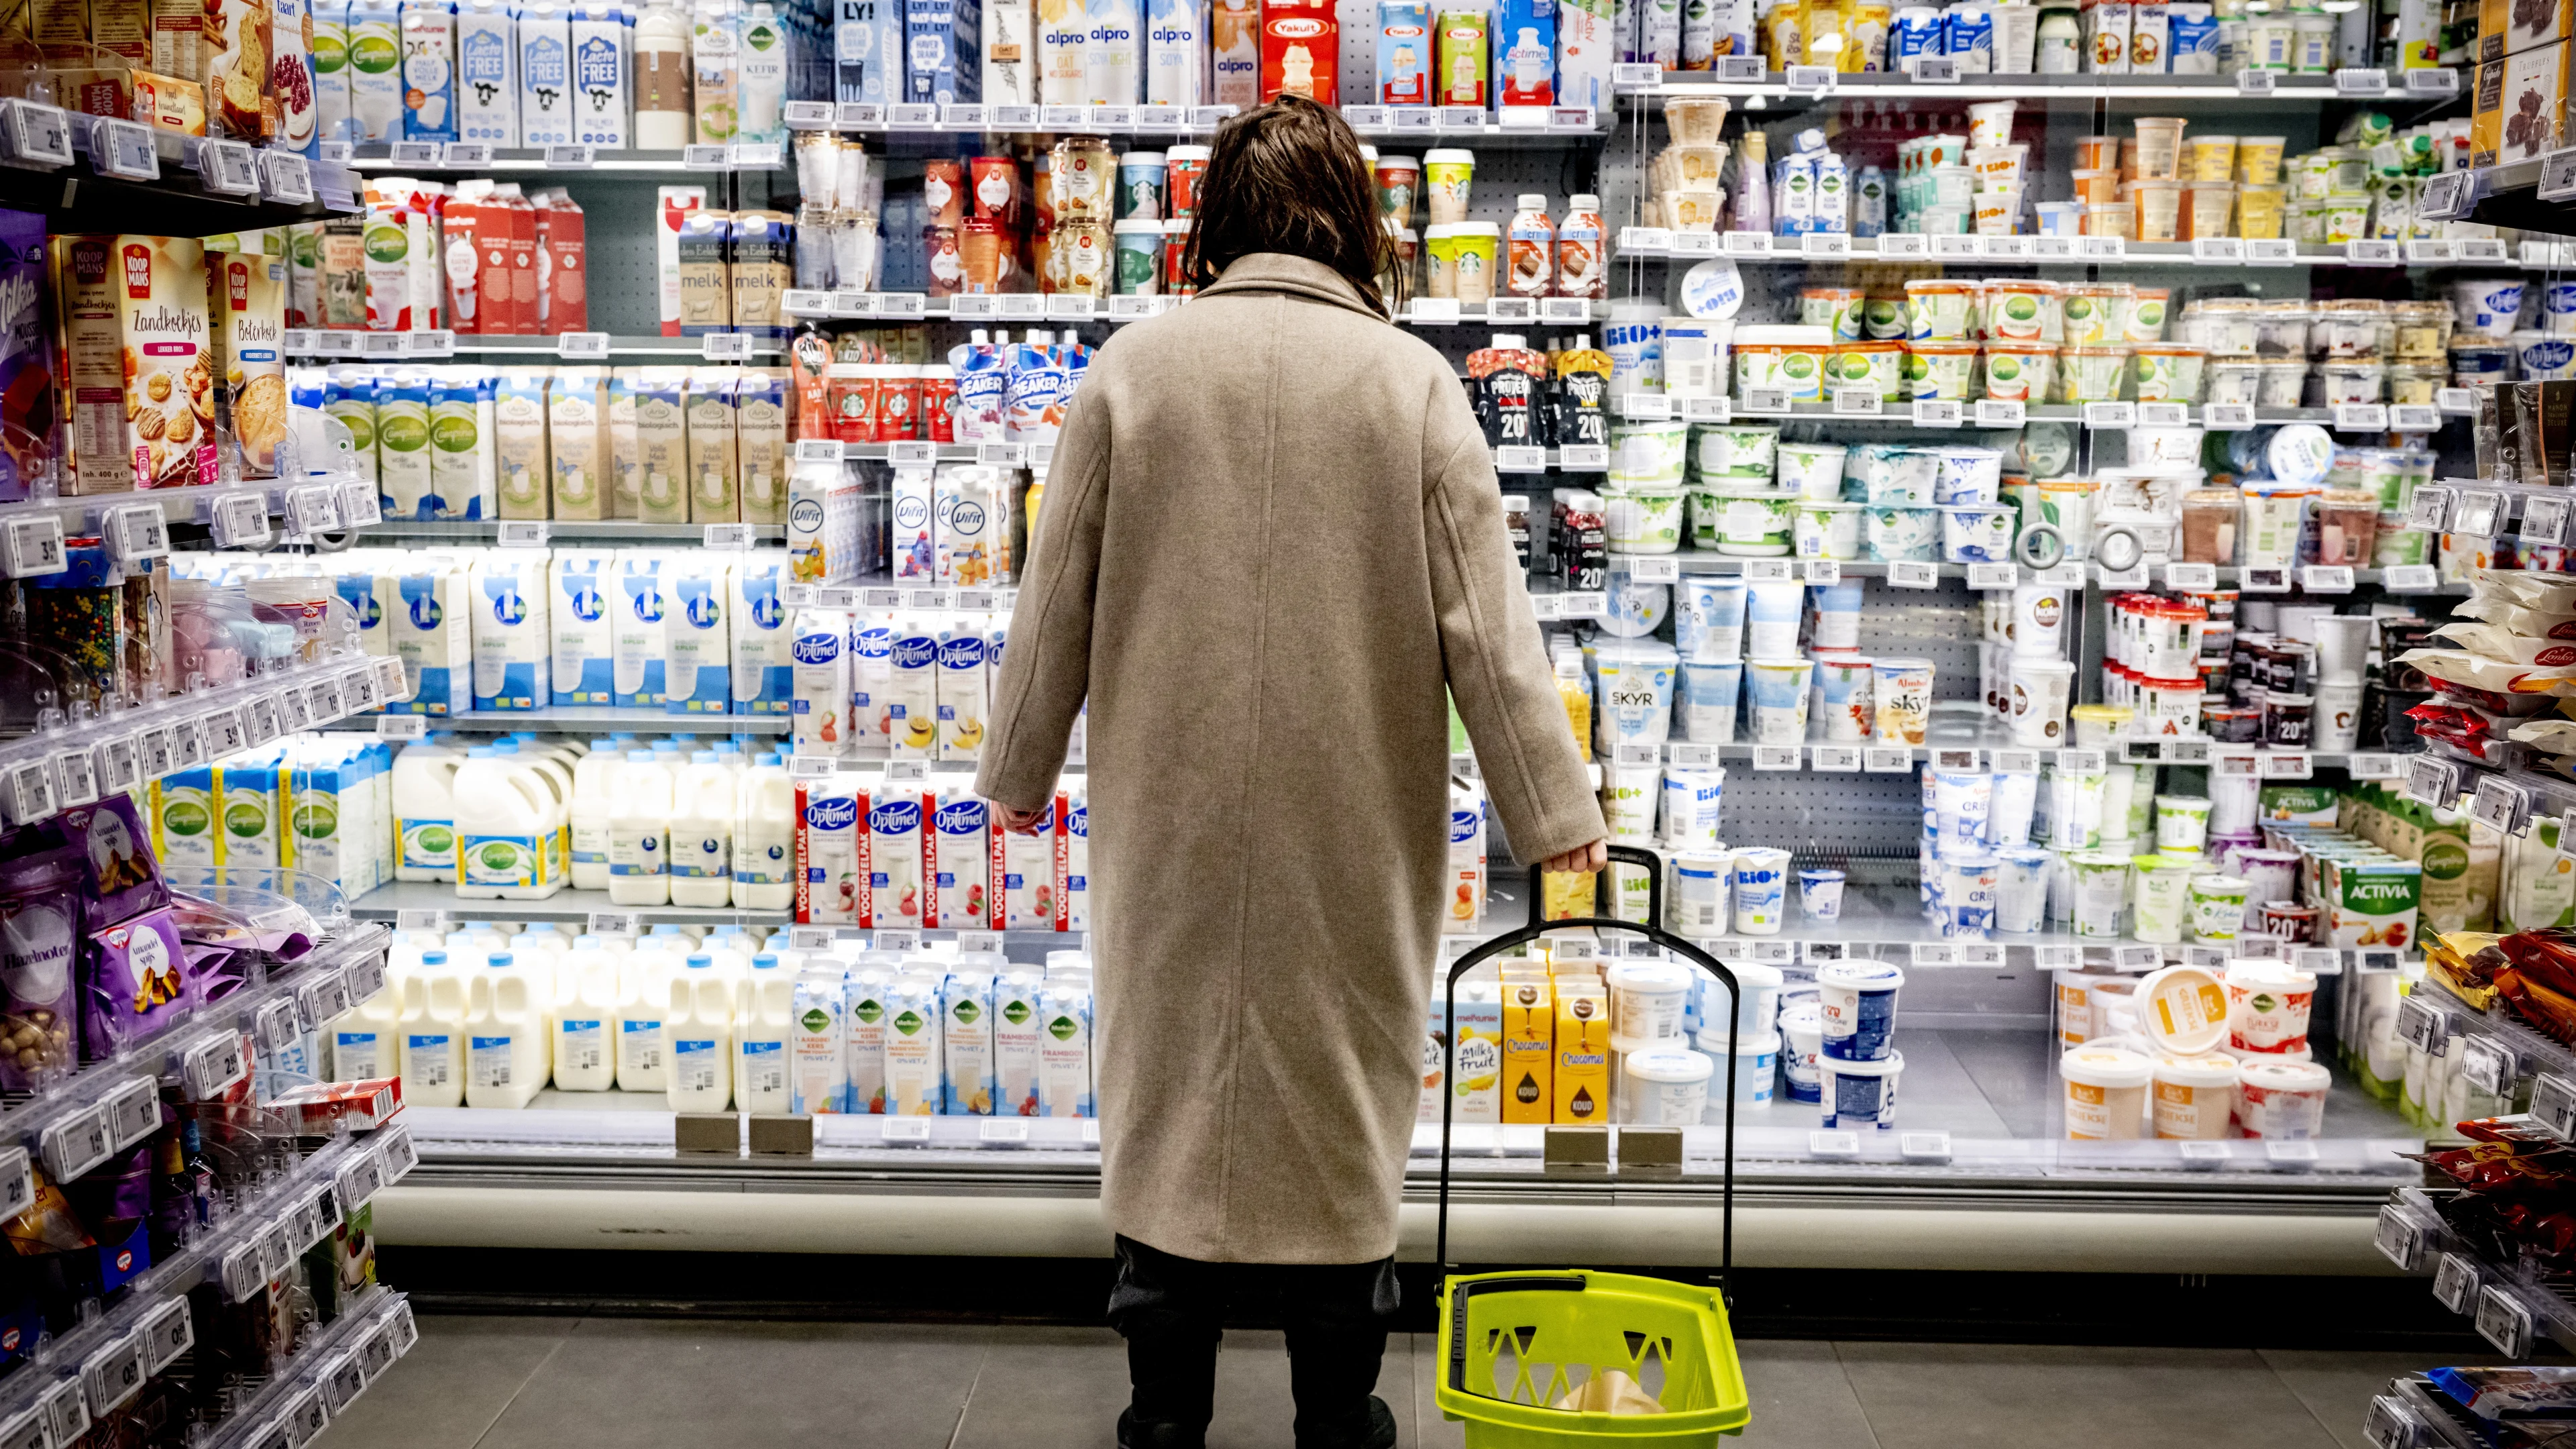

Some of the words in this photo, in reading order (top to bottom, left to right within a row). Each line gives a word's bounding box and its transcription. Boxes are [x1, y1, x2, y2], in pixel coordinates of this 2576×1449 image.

[1091, 25, 1129, 43] alpro
[1153, 26, 1191, 44] alpro
[1279, 23, 1317, 34] Yakult
[1046, 30, 1084, 47] alpro
[580, 48, 615, 64] Lacto
[2519, 57, 2550, 72] TRUFFLES
[467, 58, 502, 76] FREE
[528, 62, 563, 81] FREE
[581, 64, 615, 83] FREE
[746, 65, 778, 74] KEFIR
[1218, 58, 1254, 74] alpro
[76, 251, 103, 262] KOOP
[127, 256, 148, 272] KOOP
[77, 262, 104, 274] MANS
[128, 271, 149, 287] MANS
[231, 272, 246, 288] KOOP
[682, 273, 722, 288] melk
[735, 273, 775, 288] melk
[231, 286, 246, 301] MANS
[133, 307, 202, 340] Zandkoekjes
[1501, 414, 1525, 438] 20
[794, 635, 838, 661] Optimel
[854, 632, 890, 657] Optime
[939, 639, 983, 665] Optimel
[2538, 647, 2575, 664] Lonka
[1613, 691, 1652, 706] SKYR
[2281, 722, 2300, 739] 20
[807, 801, 854, 828] Optimel
[871, 805, 918, 833] Optimel
[936, 805, 983, 833] Optimel
[796, 828, 809, 913] VOORDEELPAK
[859, 833, 870, 918] VOORDEELPAK
[925, 833, 936, 918] VOORDEELPAK
[993, 834, 1004, 920] VOORDEELPAK
[1057, 835, 1069, 922] VOORDEELPAK
[2350, 884, 2411, 900] ACTIVIA
[1507, 1038, 1549, 1053] Chocomel
[1460, 1057, 1495, 1071] Fruit
[1561, 1052, 1605, 1067] Chocomel
[1519, 1086, 1539, 1097] KOUD
[1572, 1099, 1593, 1112] KOUD
